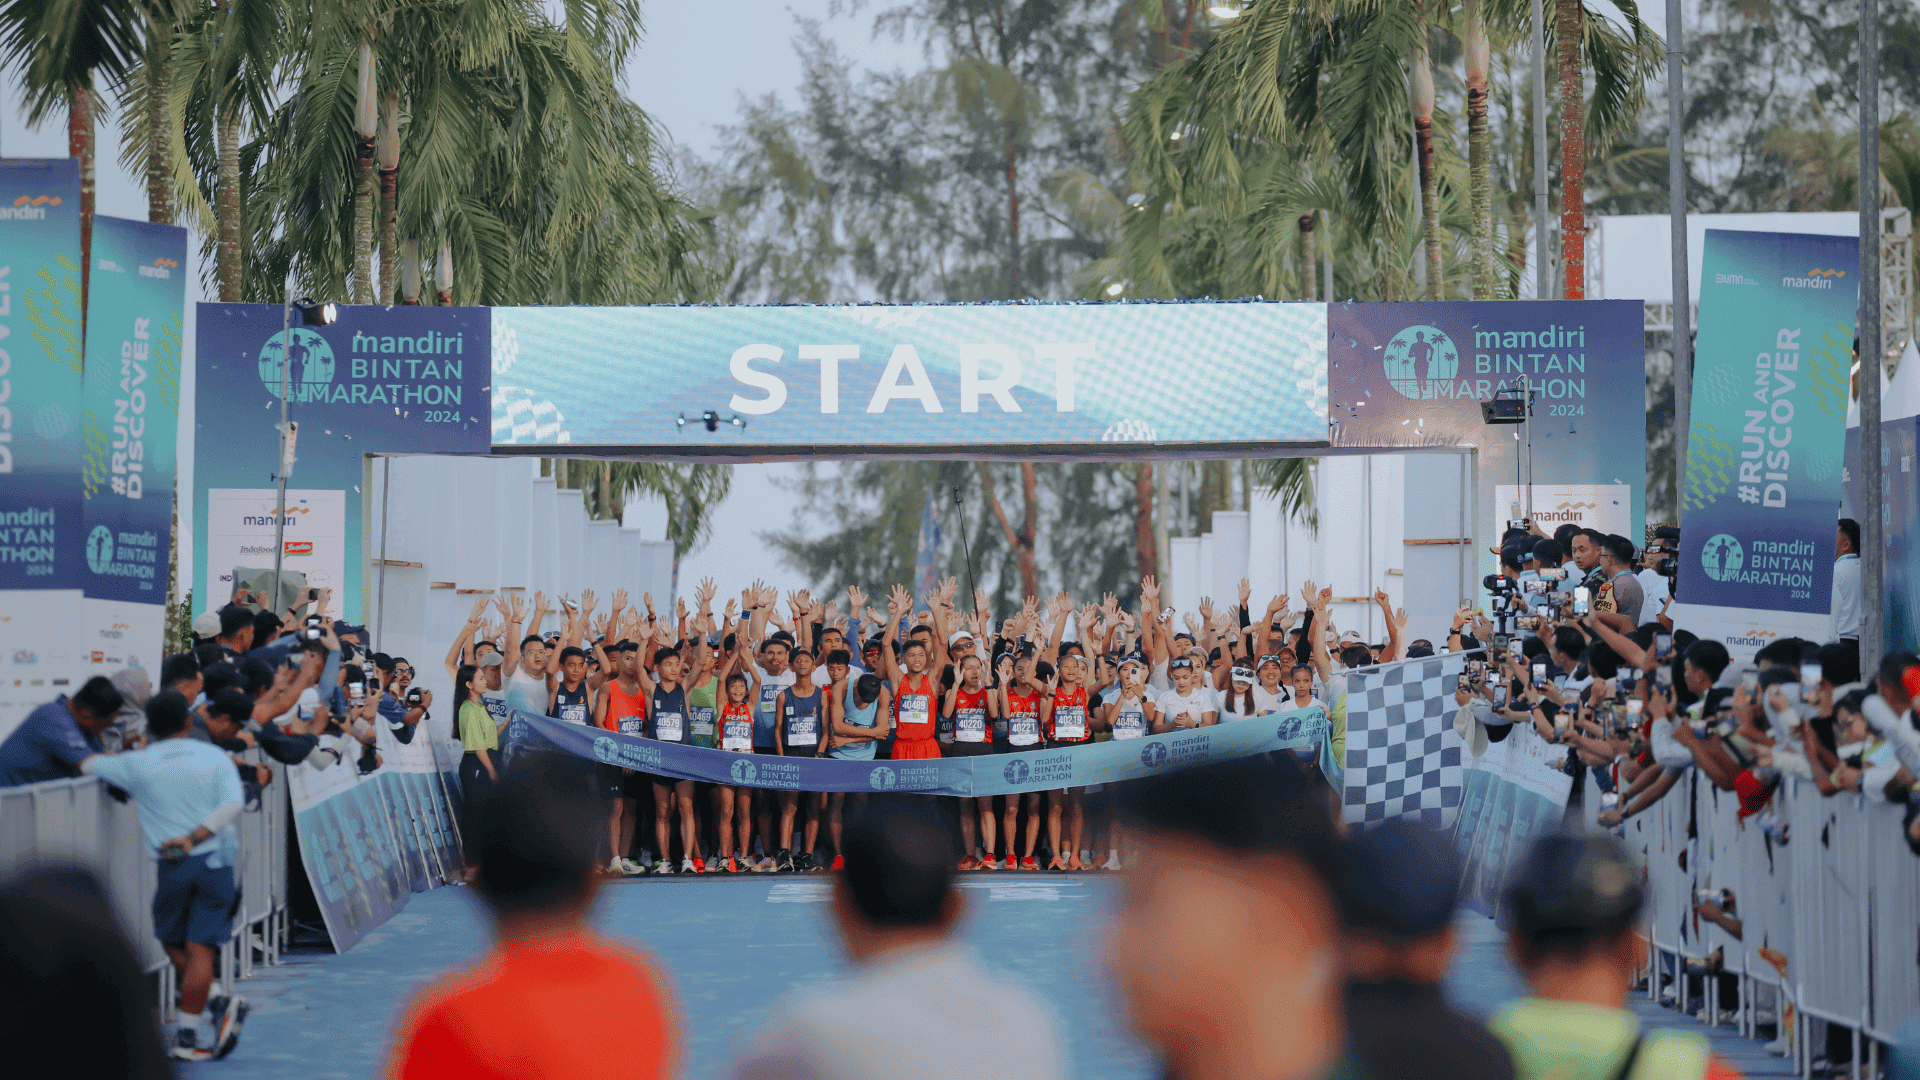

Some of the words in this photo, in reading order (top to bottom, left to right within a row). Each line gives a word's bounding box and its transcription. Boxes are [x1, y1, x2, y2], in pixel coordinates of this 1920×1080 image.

[1783, 276, 1831, 289] mandiri
[352, 331, 463, 354] mandiri
[1475, 325, 1585, 348] mandiri
[351, 359, 462, 379] BINTAN
[1475, 353, 1585, 374] BINTAN
[728, 343, 1096, 415] START
[309, 384, 462, 405] MARATHON
[127, 317, 150, 499] DISCOVER
[1549, 405, 1585, 416] 2024
[111, 399, 129, 496] #RUN
[120, 341, 131, 393] AND
[424, 411, 461, 422] 2024
[1763, 328, 1801, 508] DISCOVER
[1738, 410, 1767, 504] #RUN
[1754, 352, 1771, 404] AND
[1532, 509, 1582, 521] mandiri
[118, 531, 158, 547] mandiri
[240, 545, 277, 555] Indofood
[1753, 539, 1815, 556] mandiri
[117, 546, 156, 563] BINTAN
[1752, 555, 1813, 572] BINTAN
[1728, 570, 1812, 588] MARATHON
[1791, 590, 1810, 599] 2024
[1726, 636, 1765, 647] mandiri
[902, 700, 926, 710] 40489
[562, 710, 585, 720] 40578
[1058, 715, 1082, 725] 40219
[657, 718, 680, 728] 40579
[959, 719, 983, 729] 40220
[1011, 723, 1035, 733] 40221
[1116, 717, 1140, 727] 40456
[726, 726, 749, 737] 40213
[1172, 734, 1210, 747] mandiri
[623, 743, 661, 756] mandiri
[1172, 743, 1209, 756] BINTAN
[623, 751, 661, 764] BINTAN
[1035, 754, 1072, 765] mandiri
[761, 763, 799, 772] mandiri
[900, 766, 939, 775] mandiri
[1034, 764, 1071, 774] BINTAN
[761, 771, 799, 780] BINTAN
[900, 775, 939, 783] BINTAN
[1020, 772, 1071, 785] MARATHON
[748, 779, 799, 788] MARATHON
